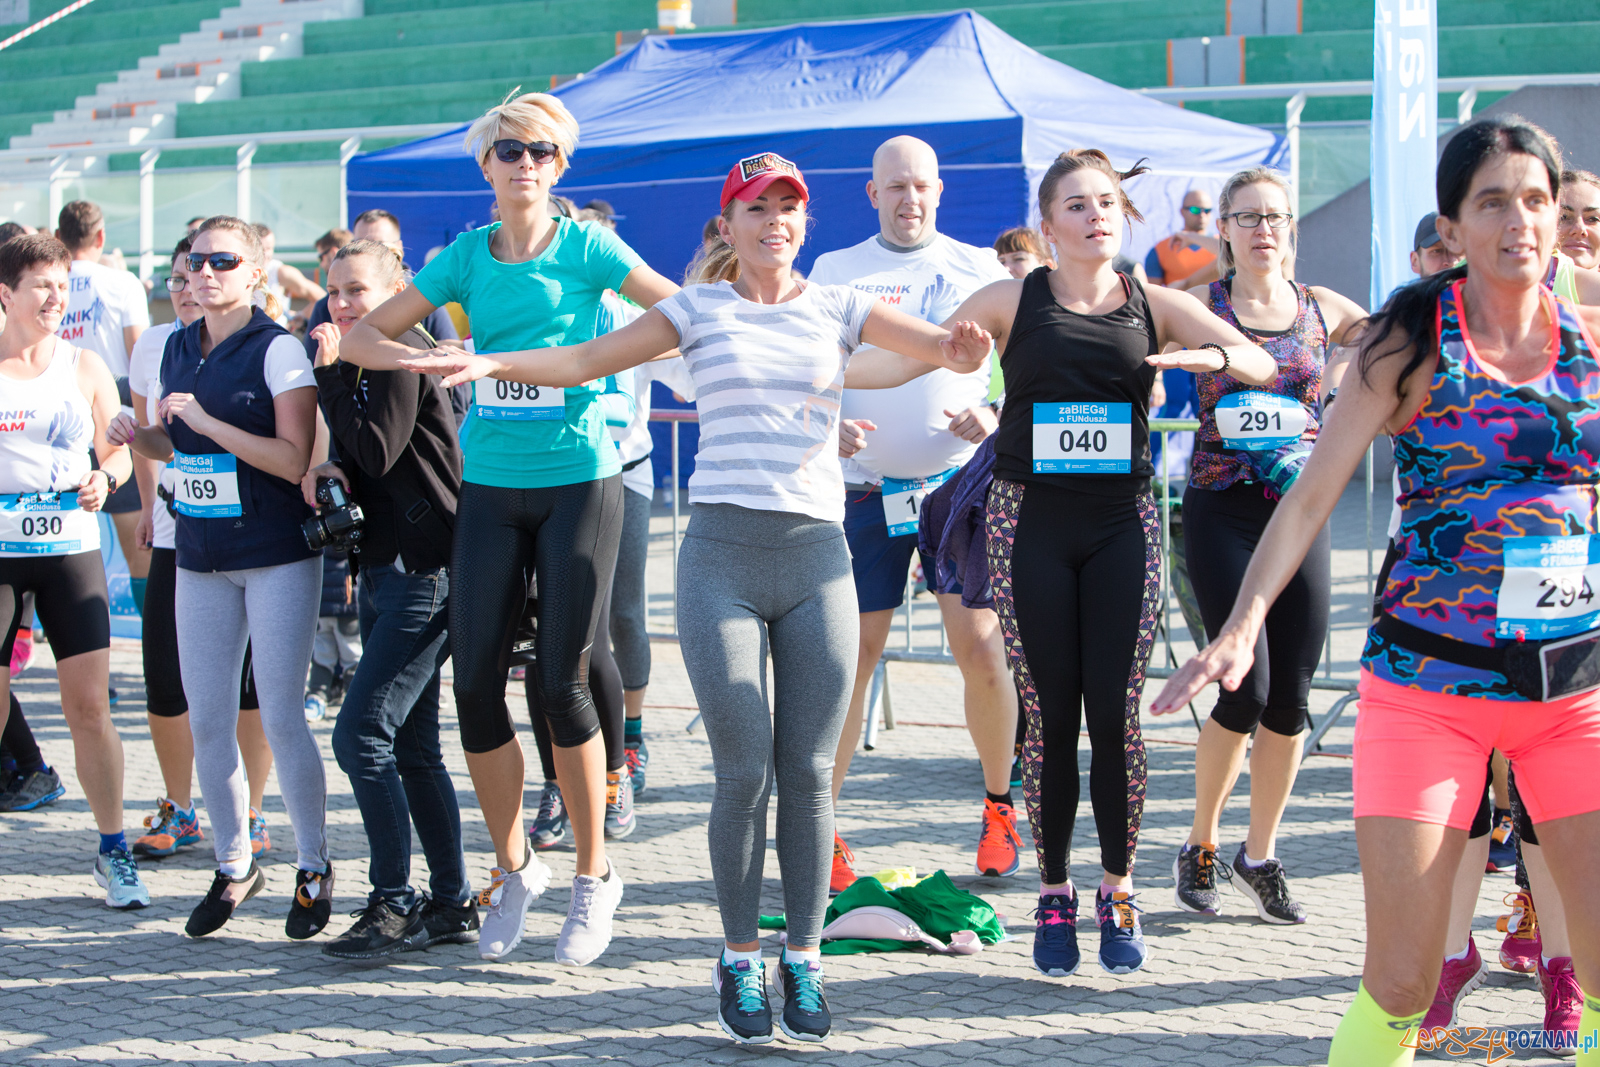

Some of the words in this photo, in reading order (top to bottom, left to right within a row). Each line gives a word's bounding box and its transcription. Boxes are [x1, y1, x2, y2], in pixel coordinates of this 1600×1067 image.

[496, 380, 539, 400] 098
[1059, 405, 1107, 416] zaBIEGaj
[1240, 411, 1281, 431] 291
[1060, 430, 1107, 452] 040
[184, 478, 217, 499] 169
[22, 516, 62, 536] 030
[1536, 575, 1594, 608] 294
